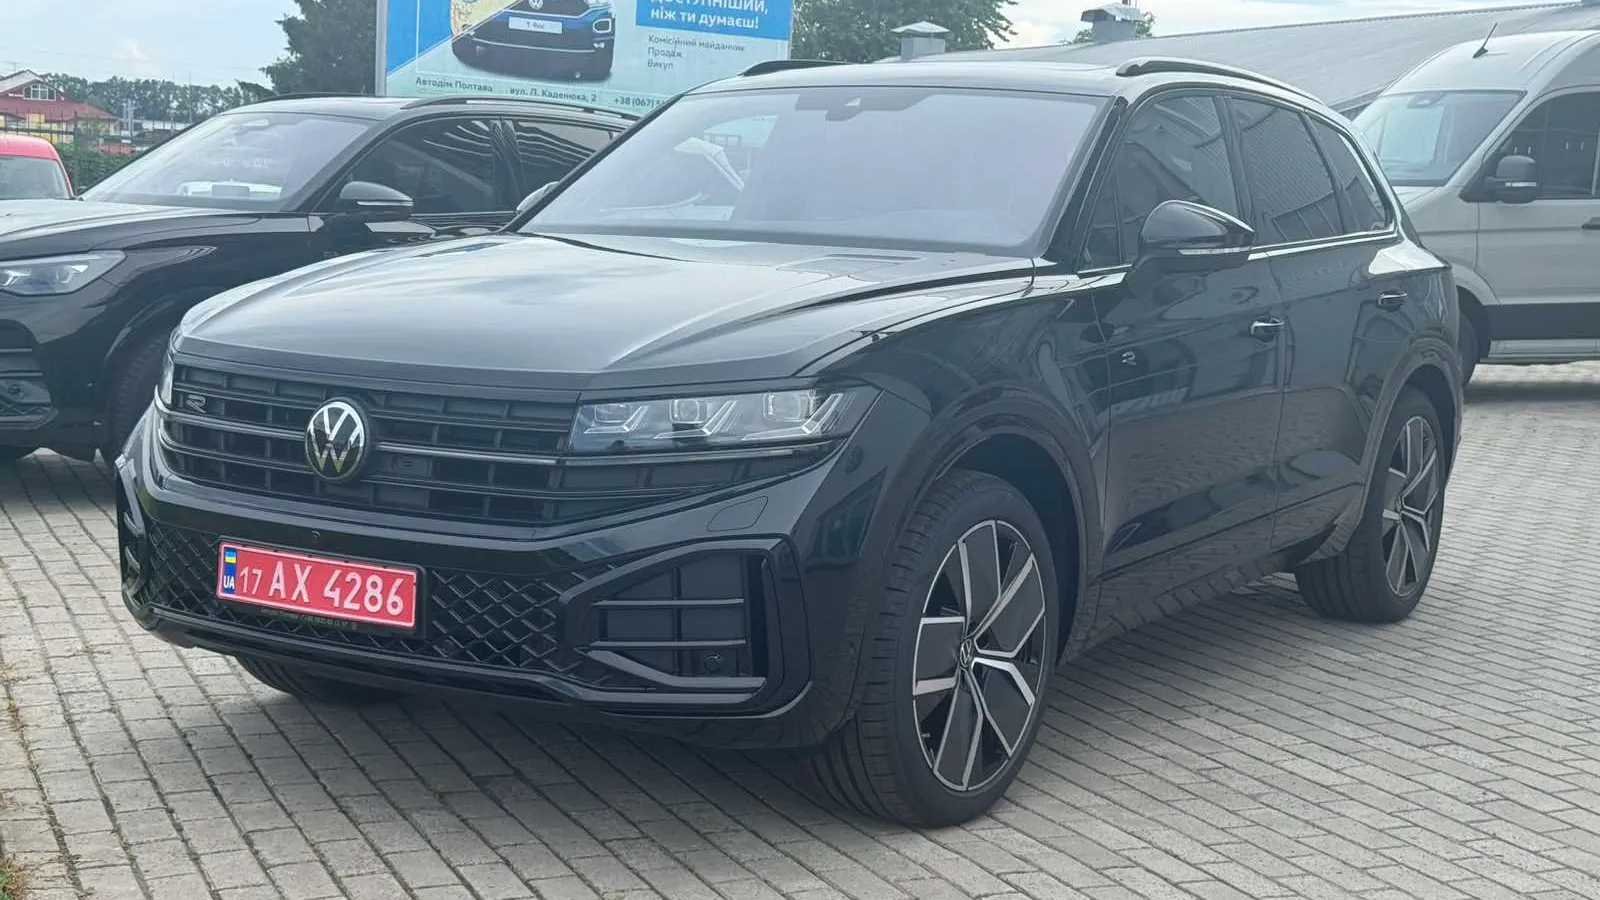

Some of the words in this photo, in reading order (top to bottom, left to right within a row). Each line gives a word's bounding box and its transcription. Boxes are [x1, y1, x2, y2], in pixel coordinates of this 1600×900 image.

[650, 6, 676, 20] ніж
[679, 11, 696, 23] ти
[698, 14, 759, 29] думаєш!
[647, 47, 683, 58] Продаж
[647, 59, 674, 71] Викуп
[416, 76, 453, 88] Автодім
[454, 80, 493, 92] Полтава
[510, 87, 529, 96] вул.
[591, 93, 597, 102] 2
[613, 95, 631, 106] +38
[632, 97, 654, 108] (067)
[223, 575, 235, 589] UA
[239, 566, 262, 596] 17
[268, 561, 312, 603] AX
[323, 569, 404, 616] 4286
